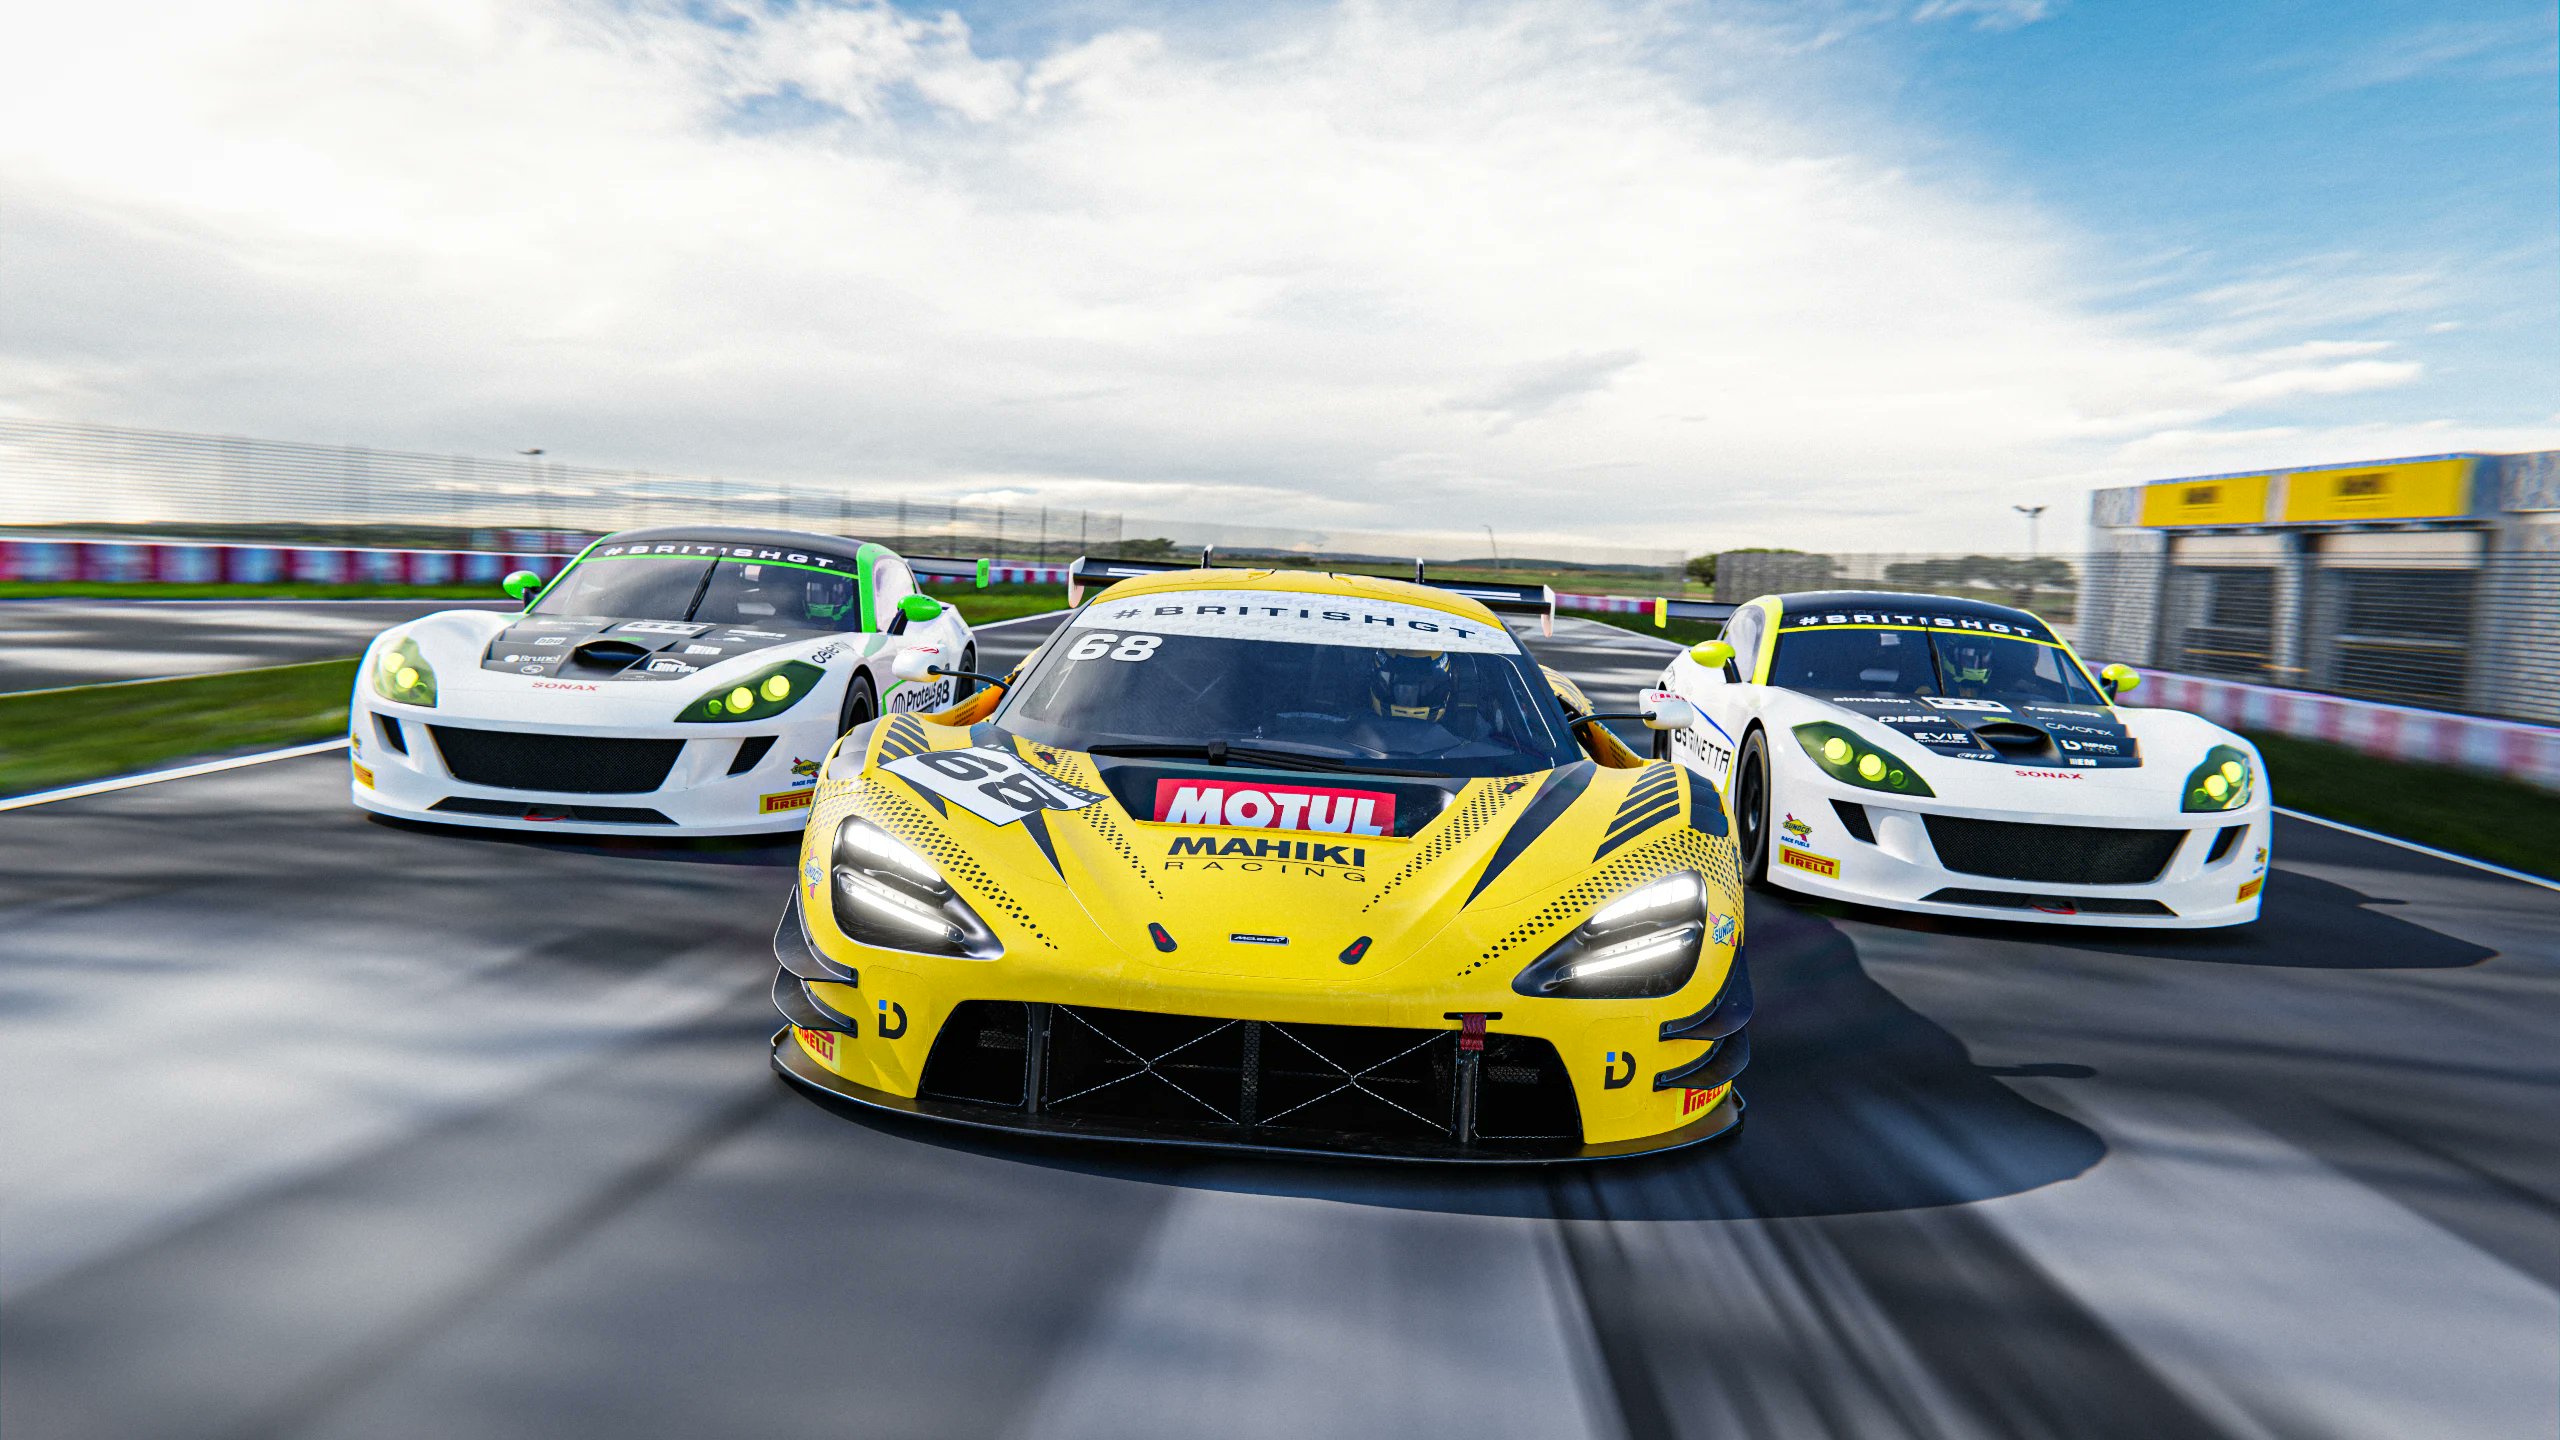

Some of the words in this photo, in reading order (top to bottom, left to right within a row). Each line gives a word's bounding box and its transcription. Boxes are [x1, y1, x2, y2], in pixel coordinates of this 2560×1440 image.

[604, 545, 833, 567] #BRITISHGT
[1112, 605, 1476, 638] #BRITISHGT
[1800, 615, 2032, 637] #BRITISHGT
[1067, 633, 1163, 663] 68
[532, 681, 600, 692] SONAX
[935, 679, 950, 708] 88
[916, 751, 1069, 812] 68
[2015, 770, 2084, 779] SONAX
[766, 790, 815, 812] PIRELL
[1165, 786, 1384, 837] MOTUL
[1168, 837, 1366, 868] MAHIKI
[1783, 848, 1835, 876] PIRELLI
[1164, 861, 1366, 882] RACING
